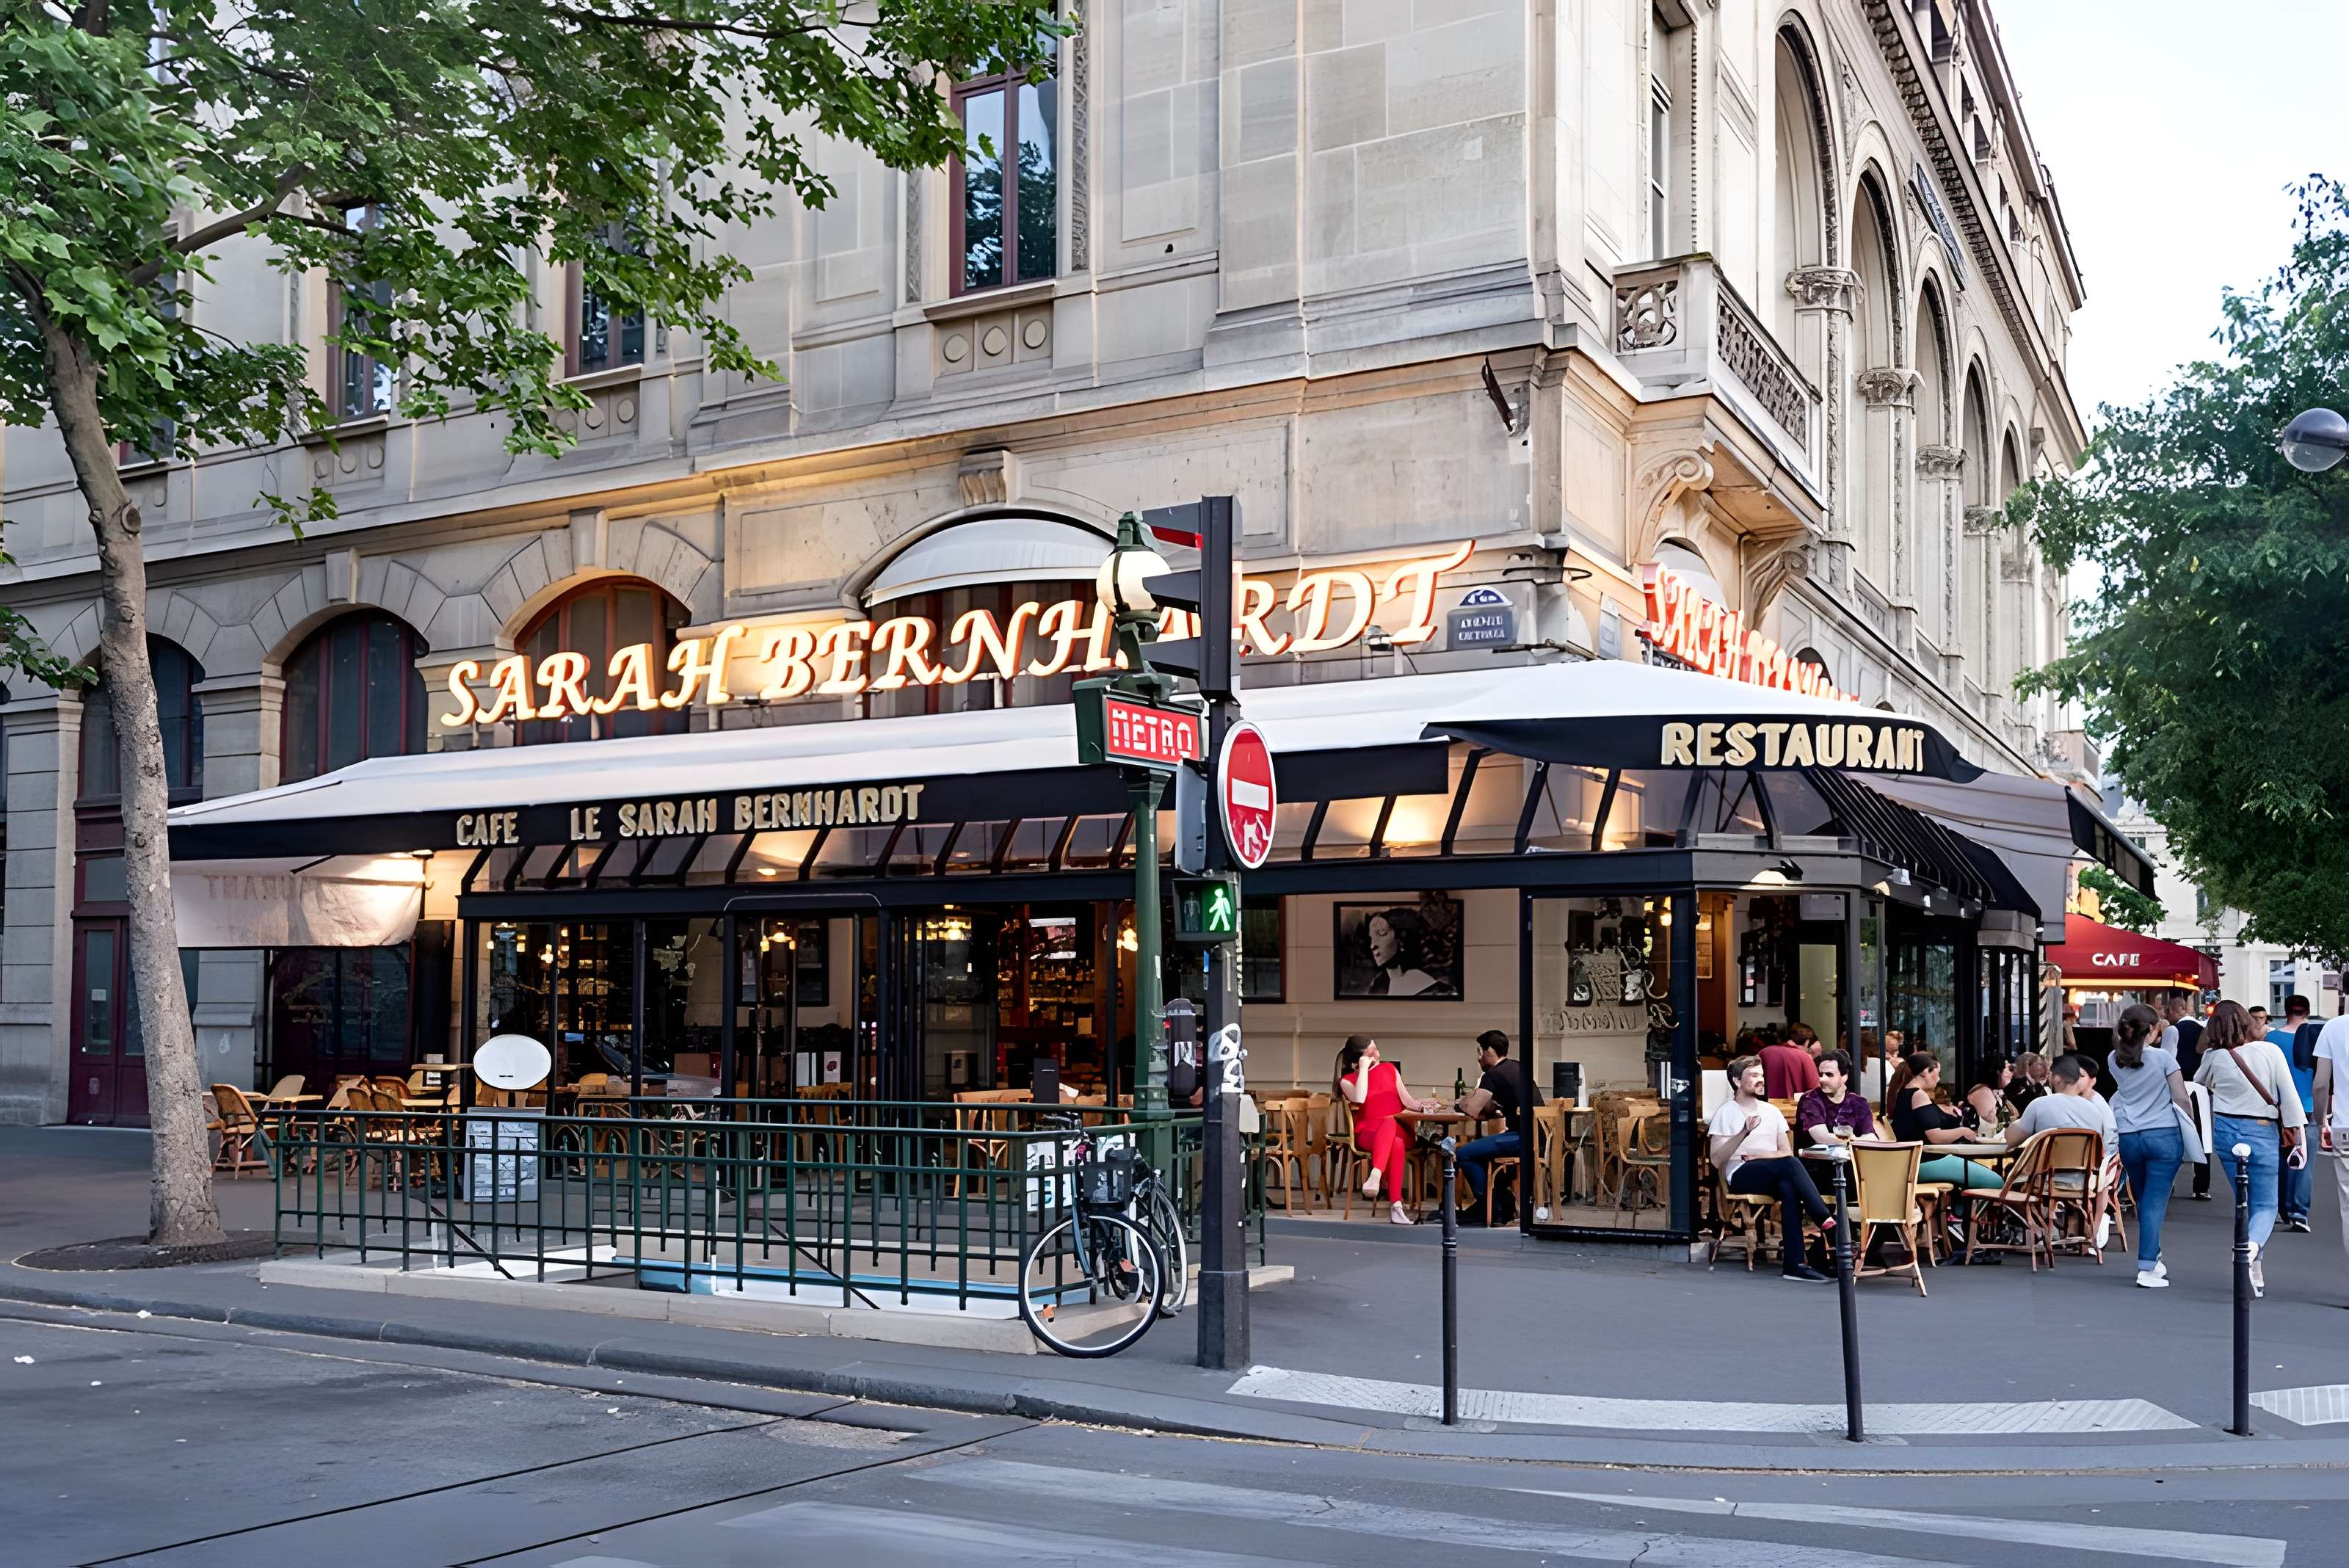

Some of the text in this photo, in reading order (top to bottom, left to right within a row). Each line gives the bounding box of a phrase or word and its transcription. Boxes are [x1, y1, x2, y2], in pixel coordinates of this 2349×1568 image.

[440, 624, 749, 727] SARAH
[1111, 708, 1194, 759] METRO
[1660, 722, 1925, 773] RESTAURANT
[455, 783, 924, 847] CAFE LE SARAH BERNHARDT
[2091, 952, 2141, 967] CAFE
